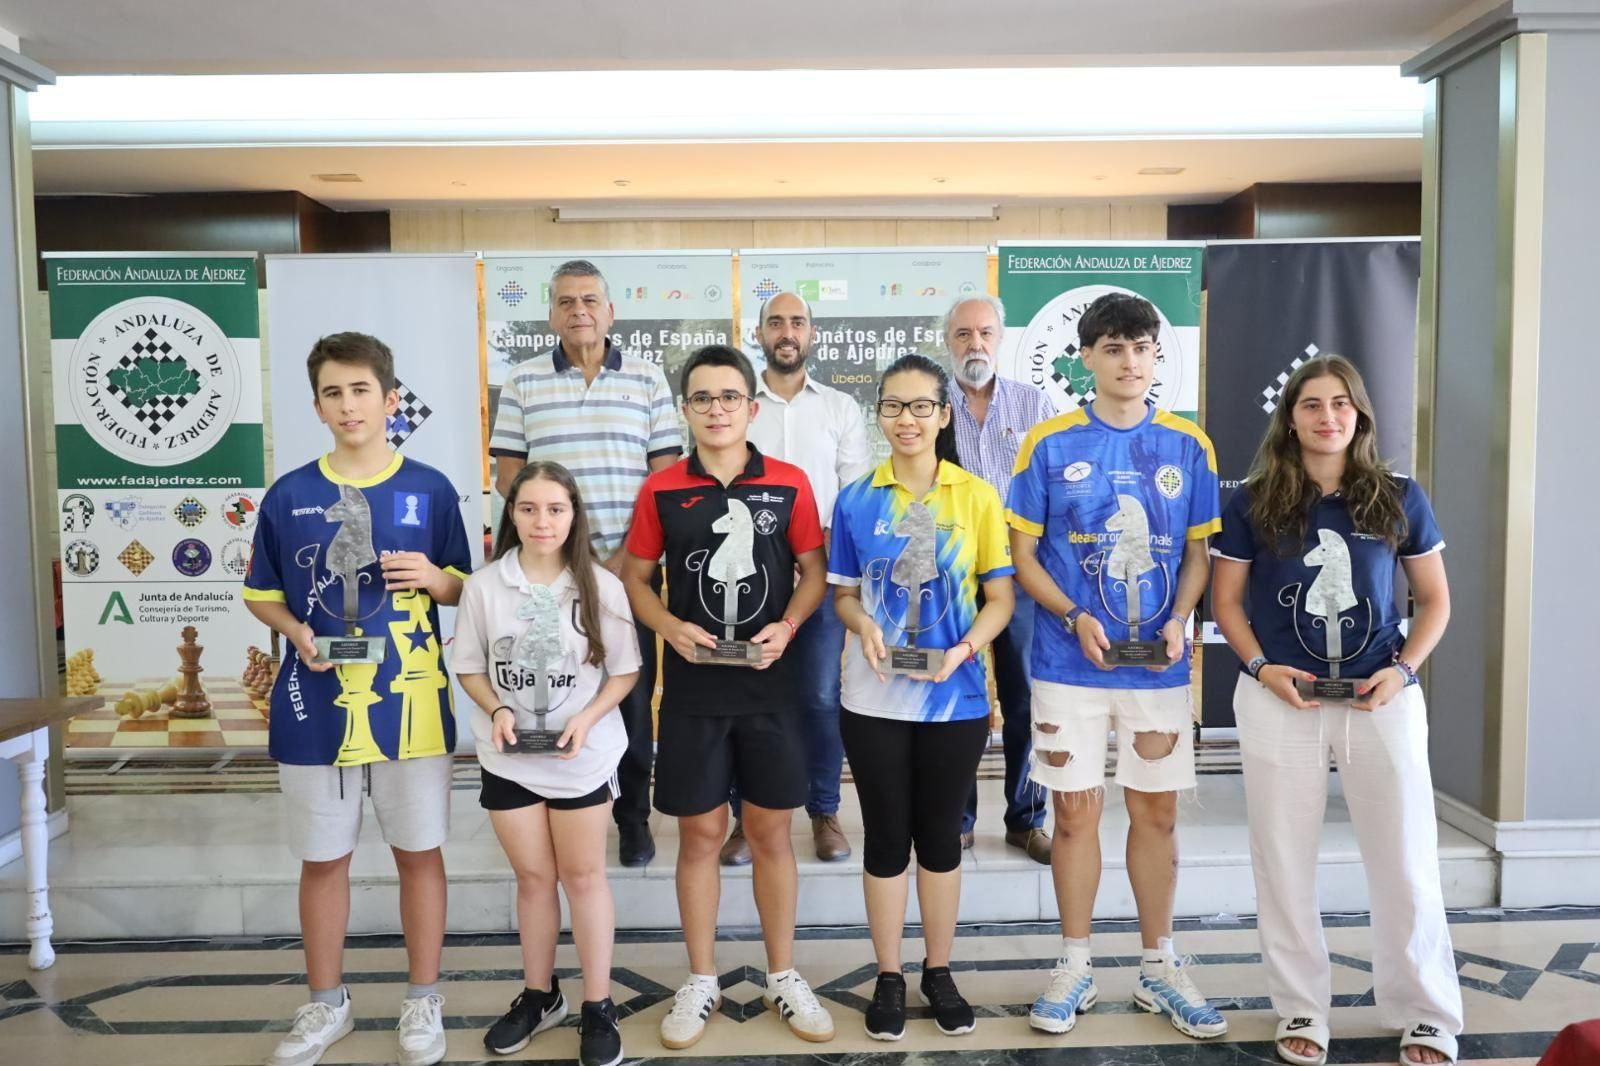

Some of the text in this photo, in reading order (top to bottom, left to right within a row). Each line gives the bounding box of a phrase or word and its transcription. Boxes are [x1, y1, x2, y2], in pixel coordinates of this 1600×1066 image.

[1008, 254, 1192, 271] FEDERACIÓN ANDALUZA DE AJEDREZ
[57, 266, 246, 282] FEDERACIÓN ANDALUZA DE AJEDREZ
[630, 329, 652, 347] de
[659, 329, 727, 352] España
[814, 326, 945, 347] onatos de Esp
[817, 345, 839, 361] de
[83, 313, 223, 449] FEDERACIÓN ANDALUZA DE AJEDREZ
[77, 475, 242, 487] www.fadajedrez.com
[139, 591, 234, 602] Junta de Andalucía
[139, 605, 230, 614] Consejería de Turismo,
[177, 615, 209, 623] Deporte
[1291, 1017, 1313, 1026] NIKE
[1416, 1023, 1440, 1036] NIKE
